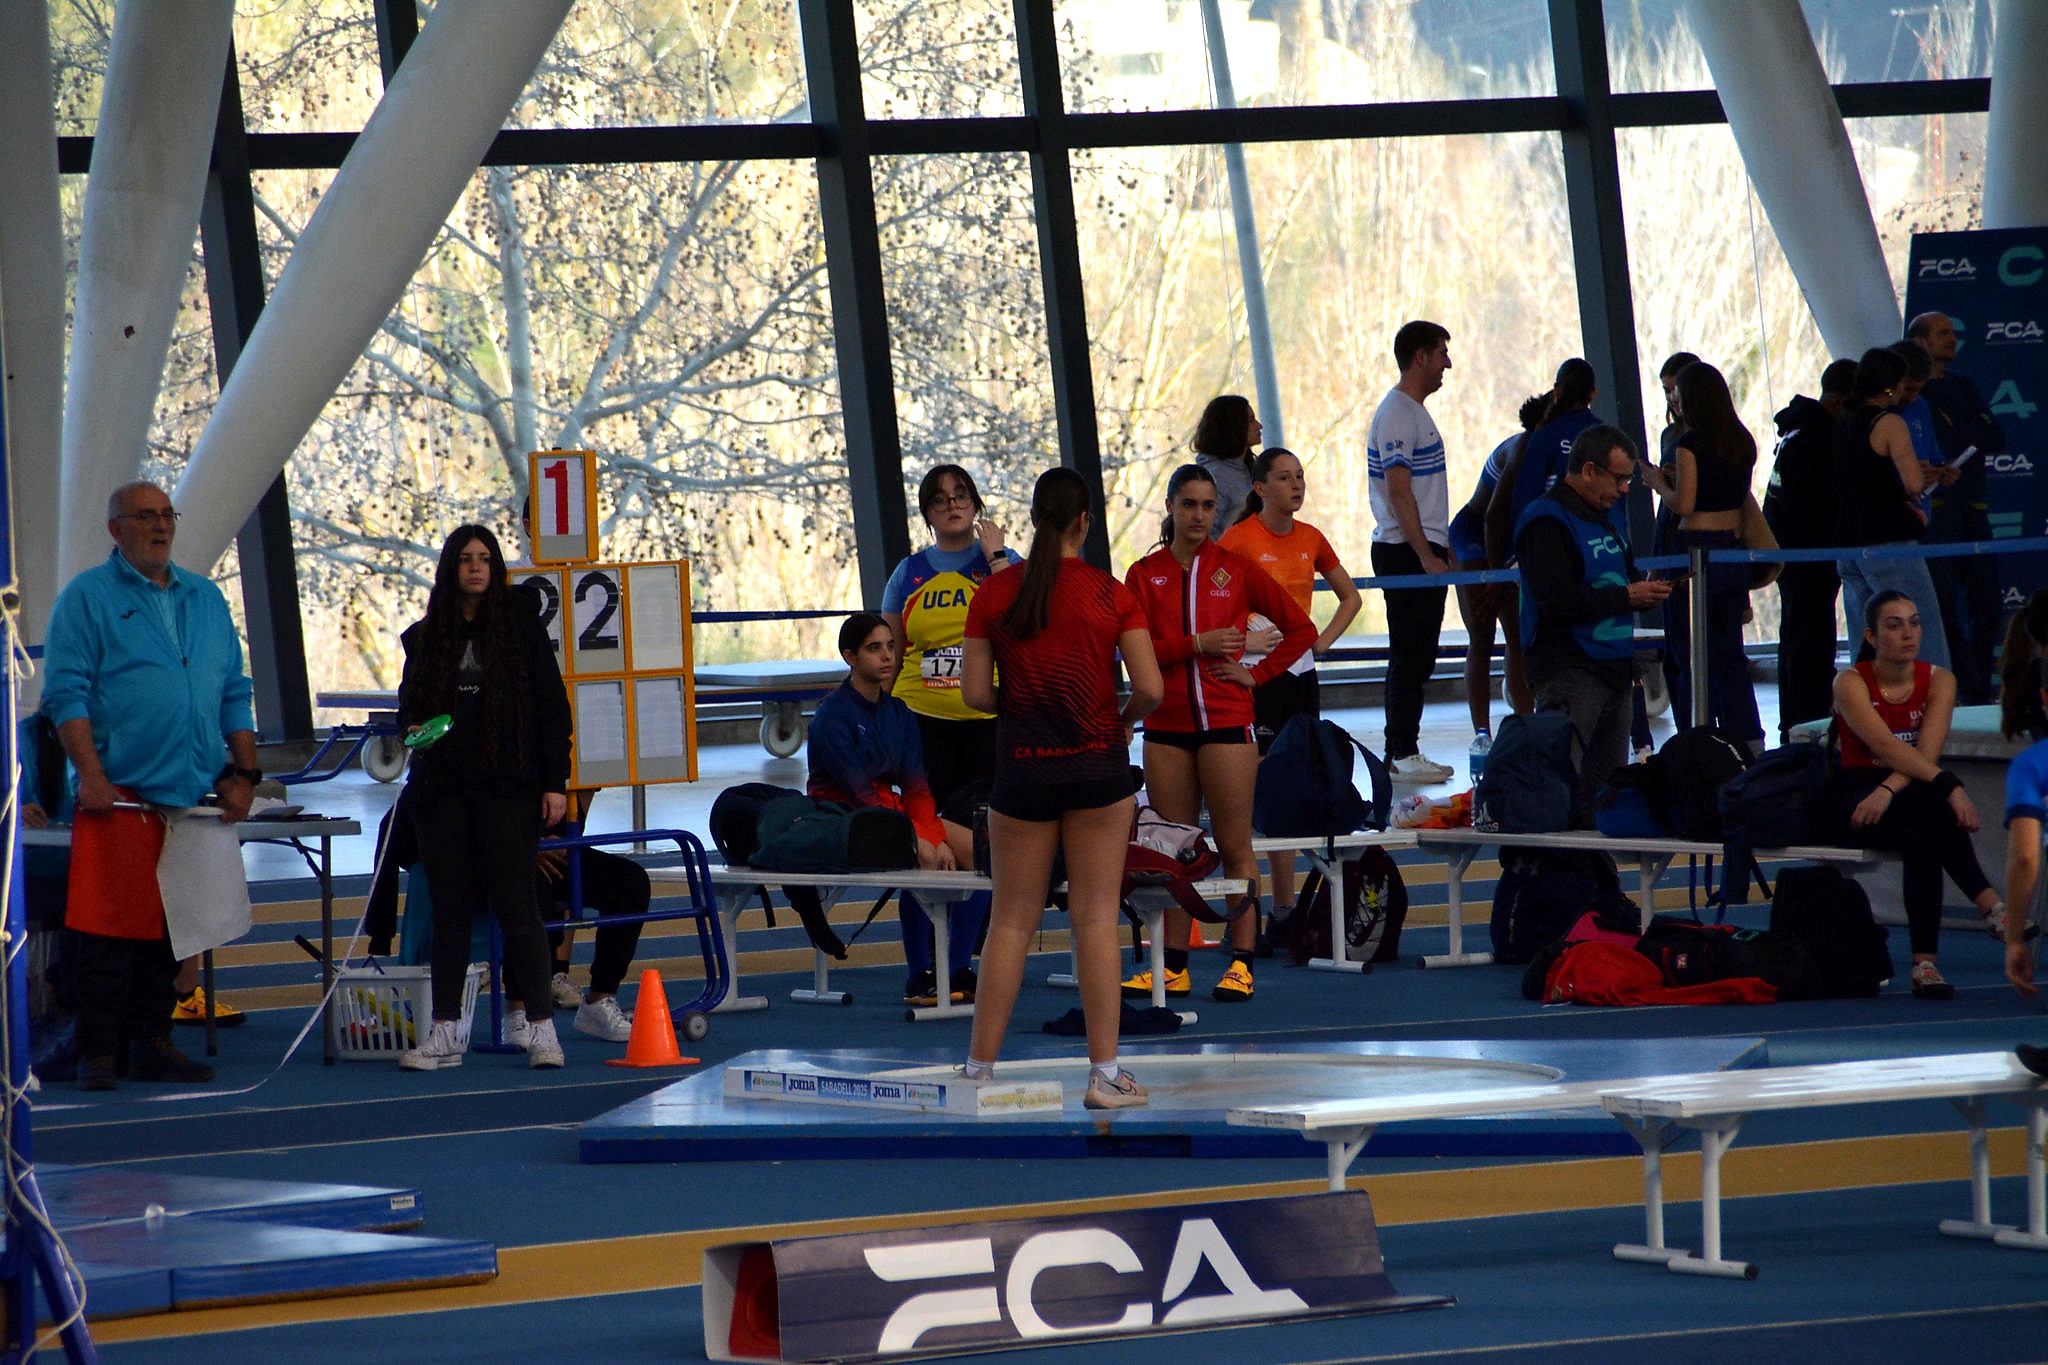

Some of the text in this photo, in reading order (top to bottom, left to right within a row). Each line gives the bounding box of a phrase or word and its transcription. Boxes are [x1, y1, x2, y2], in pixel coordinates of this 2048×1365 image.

[1918, 257, 1977, 278] FCA
[1985, 320, 2045, 340] FCA
[544, 460, 569, 535] 1
[923, 589, 968, 609] UCA
[862, 1217, 1311, 1355] FCA
